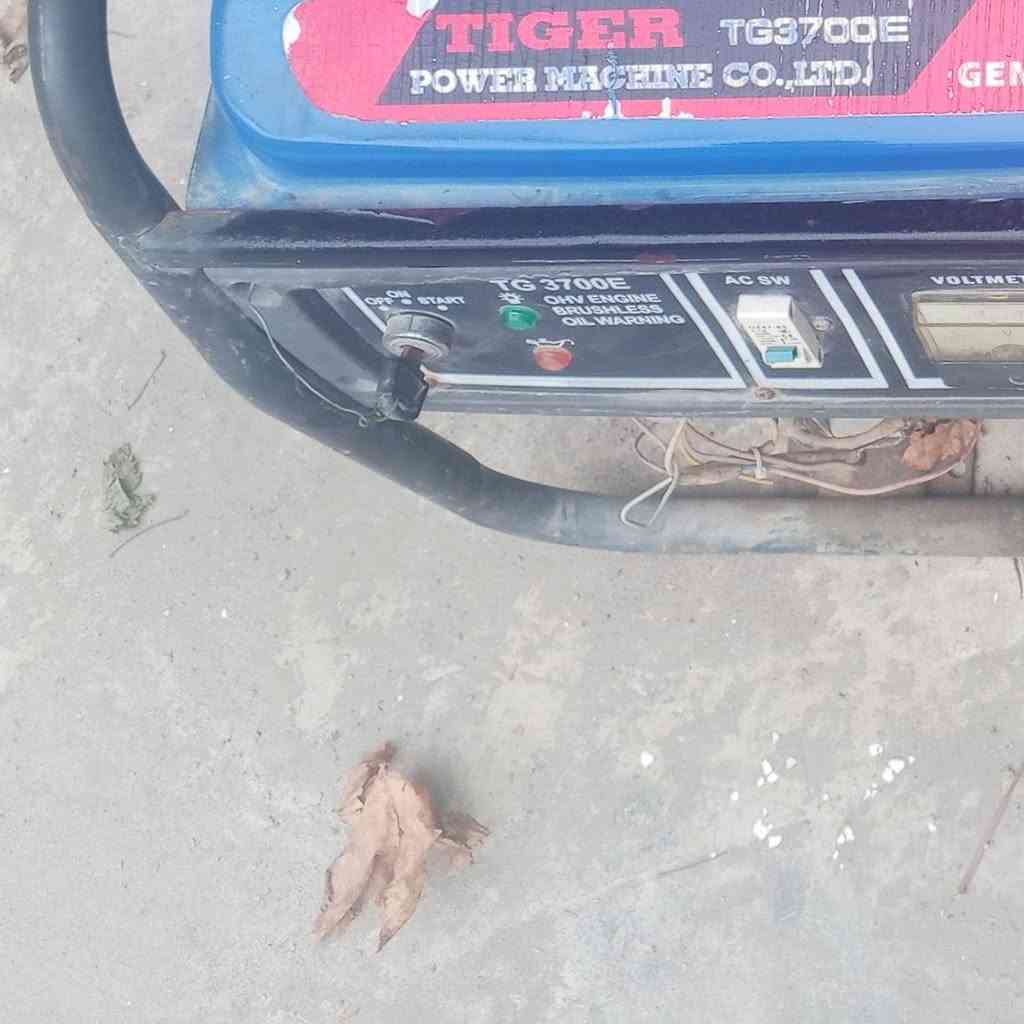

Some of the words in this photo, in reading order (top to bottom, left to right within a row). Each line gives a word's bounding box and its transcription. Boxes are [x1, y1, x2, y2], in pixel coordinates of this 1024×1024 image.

[434, 7, 687, 53] TIGER
[719, 15, 910, 46] TG3700E
[408, 66, 538, 95] POWER
[543, 62, 714, 91] MACHINE
[489, 278, 537, 292] TG
[539, 277, 631, 291] 3700E
[724, 276, 751, 285] AC
[757, 275, 791, 286] SW
[385, 290, 412, 298] ON
[543, 294, 585, 305] OHV
[588, 293, 662, 304] ENGINE
[364, 296, 395, 305] OFF
[417, 296, 465, 305] START
[552, 304, 664, 316] BRUSHLESS
[561, 316, 596, 327] OIL
[596, 314, 686, 326] WARNING
